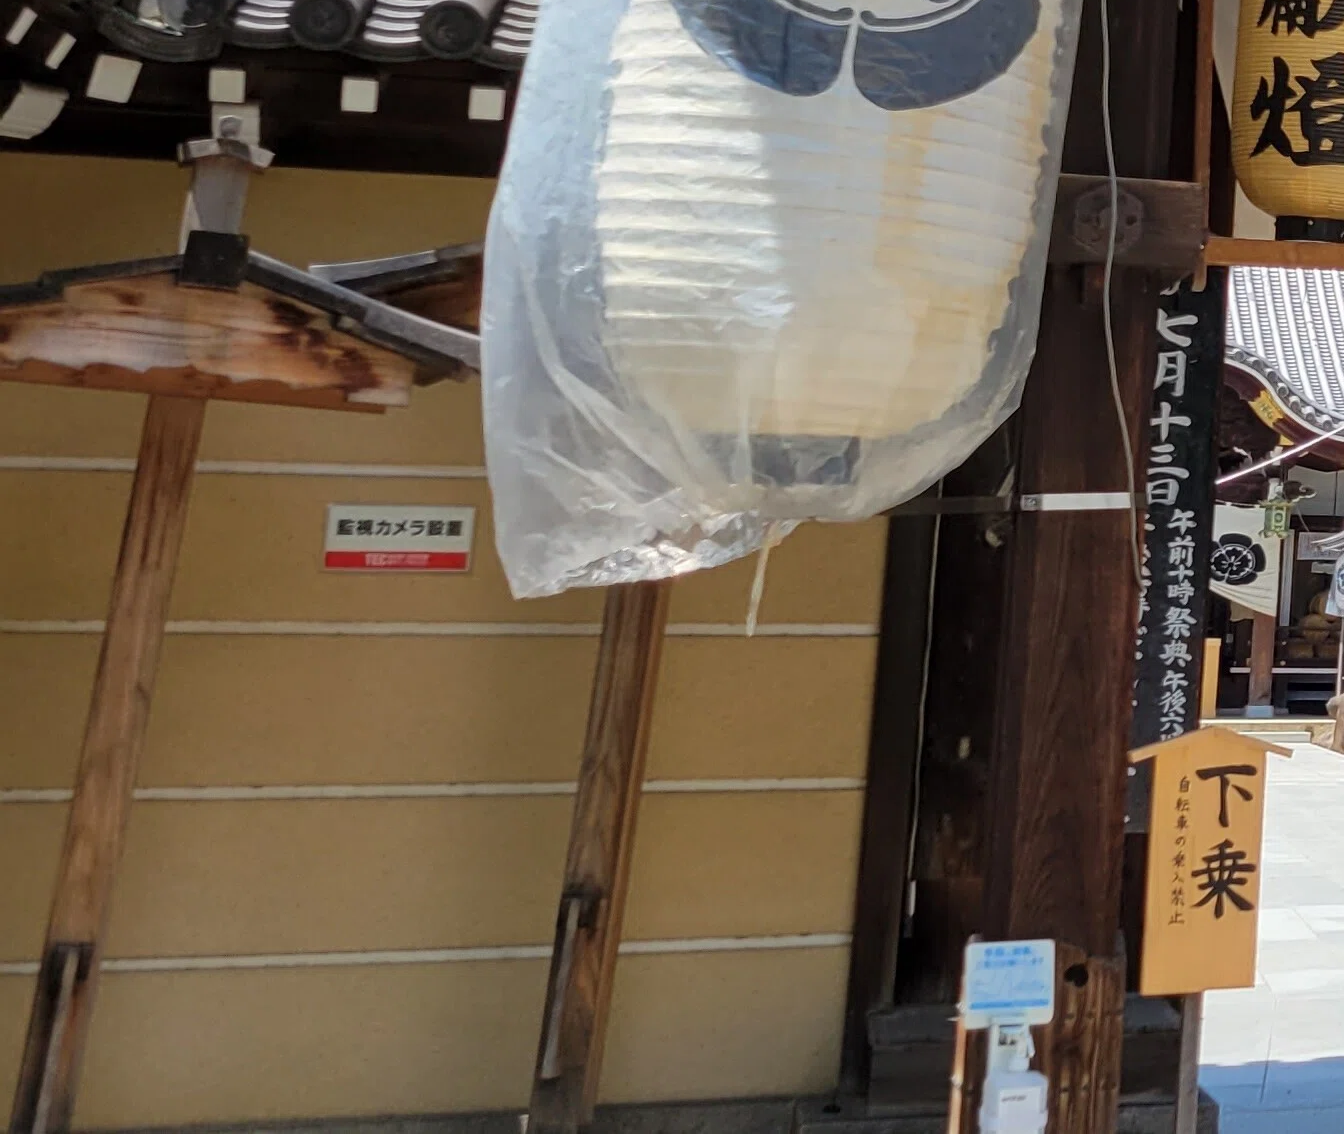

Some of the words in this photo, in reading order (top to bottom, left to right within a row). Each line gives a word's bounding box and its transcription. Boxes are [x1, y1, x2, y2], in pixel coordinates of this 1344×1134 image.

[1145, 308, 1199, 506] 七月十三日
[336, 518, 464, 537] 監視カメラ設置
[1190, 764, 1258, 919] 下乗
